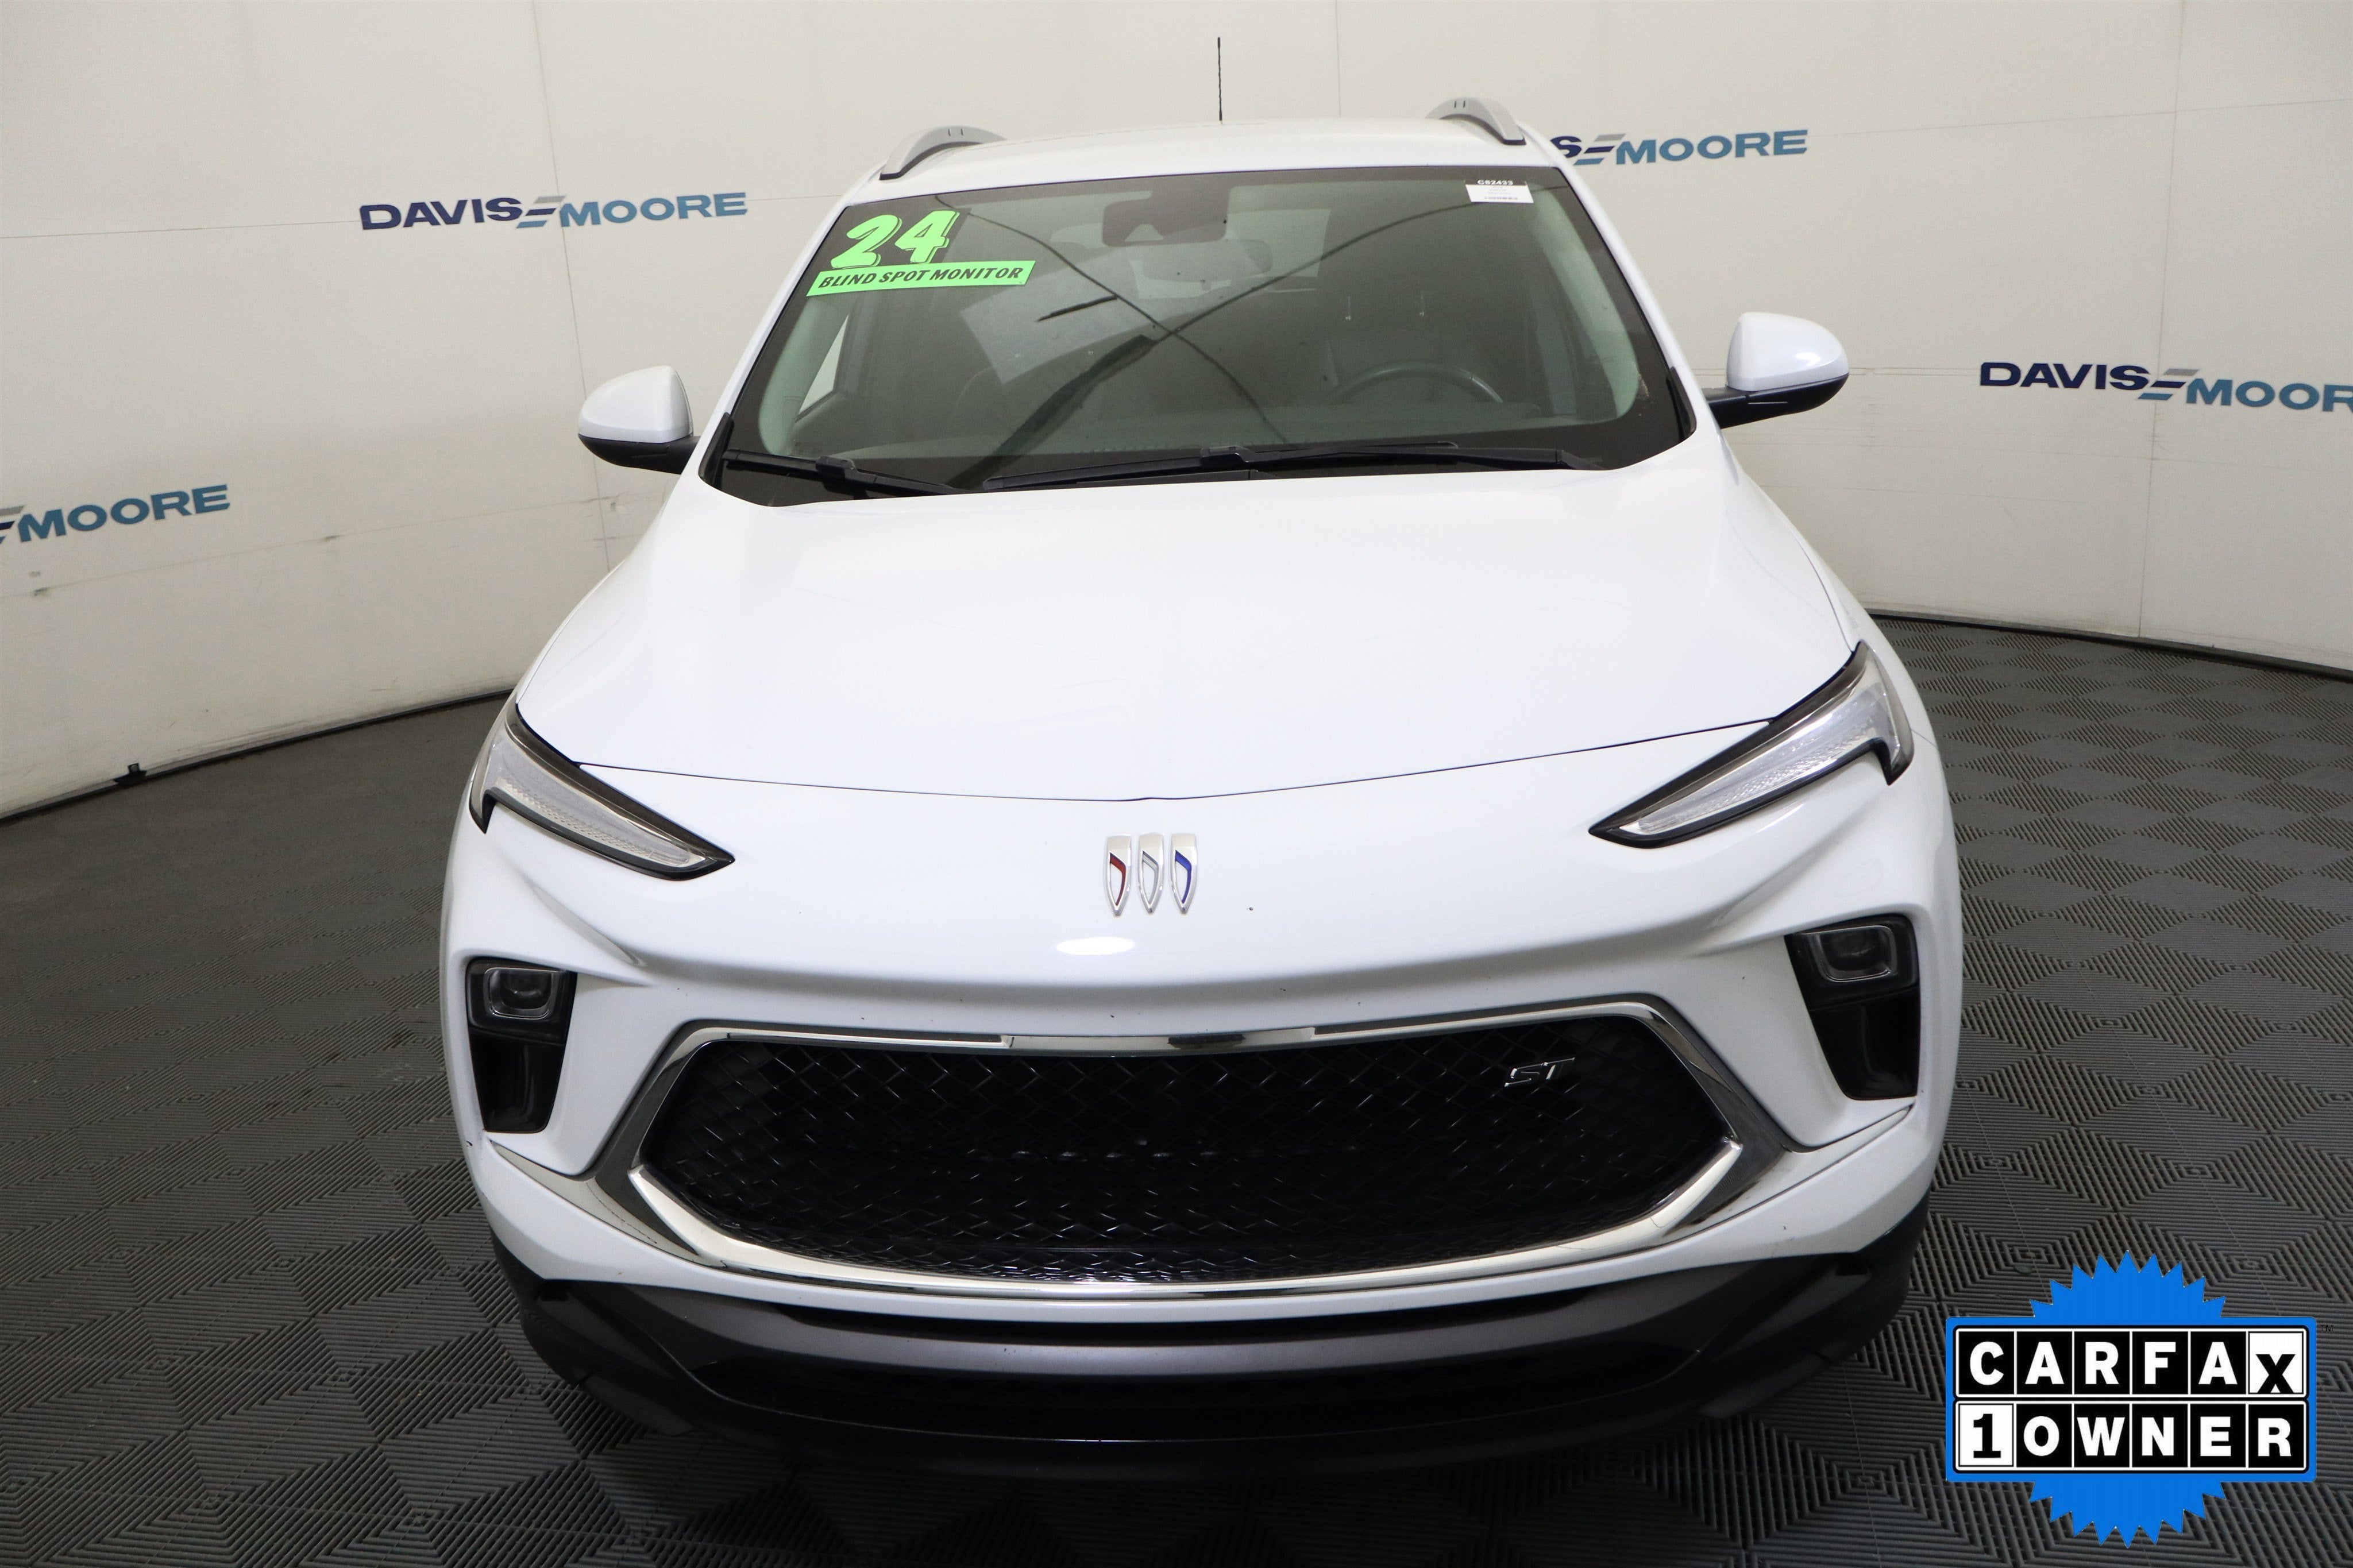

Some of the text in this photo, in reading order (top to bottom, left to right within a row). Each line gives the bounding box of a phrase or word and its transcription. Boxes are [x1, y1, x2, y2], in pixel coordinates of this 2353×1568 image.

[1616, 130, 1808, 165] MOORE
[360, 192, 748, 230] DAVIS MOORE
[831, 210, 960, 269] 24
[818, 268, 1024, 288] BLIND SPOT MONITOR
[1980, 362, 2150, 391] DAVIS
[17, 484, 230, 543] MOORE
[1504, 1057, 1576, 1088] ST
